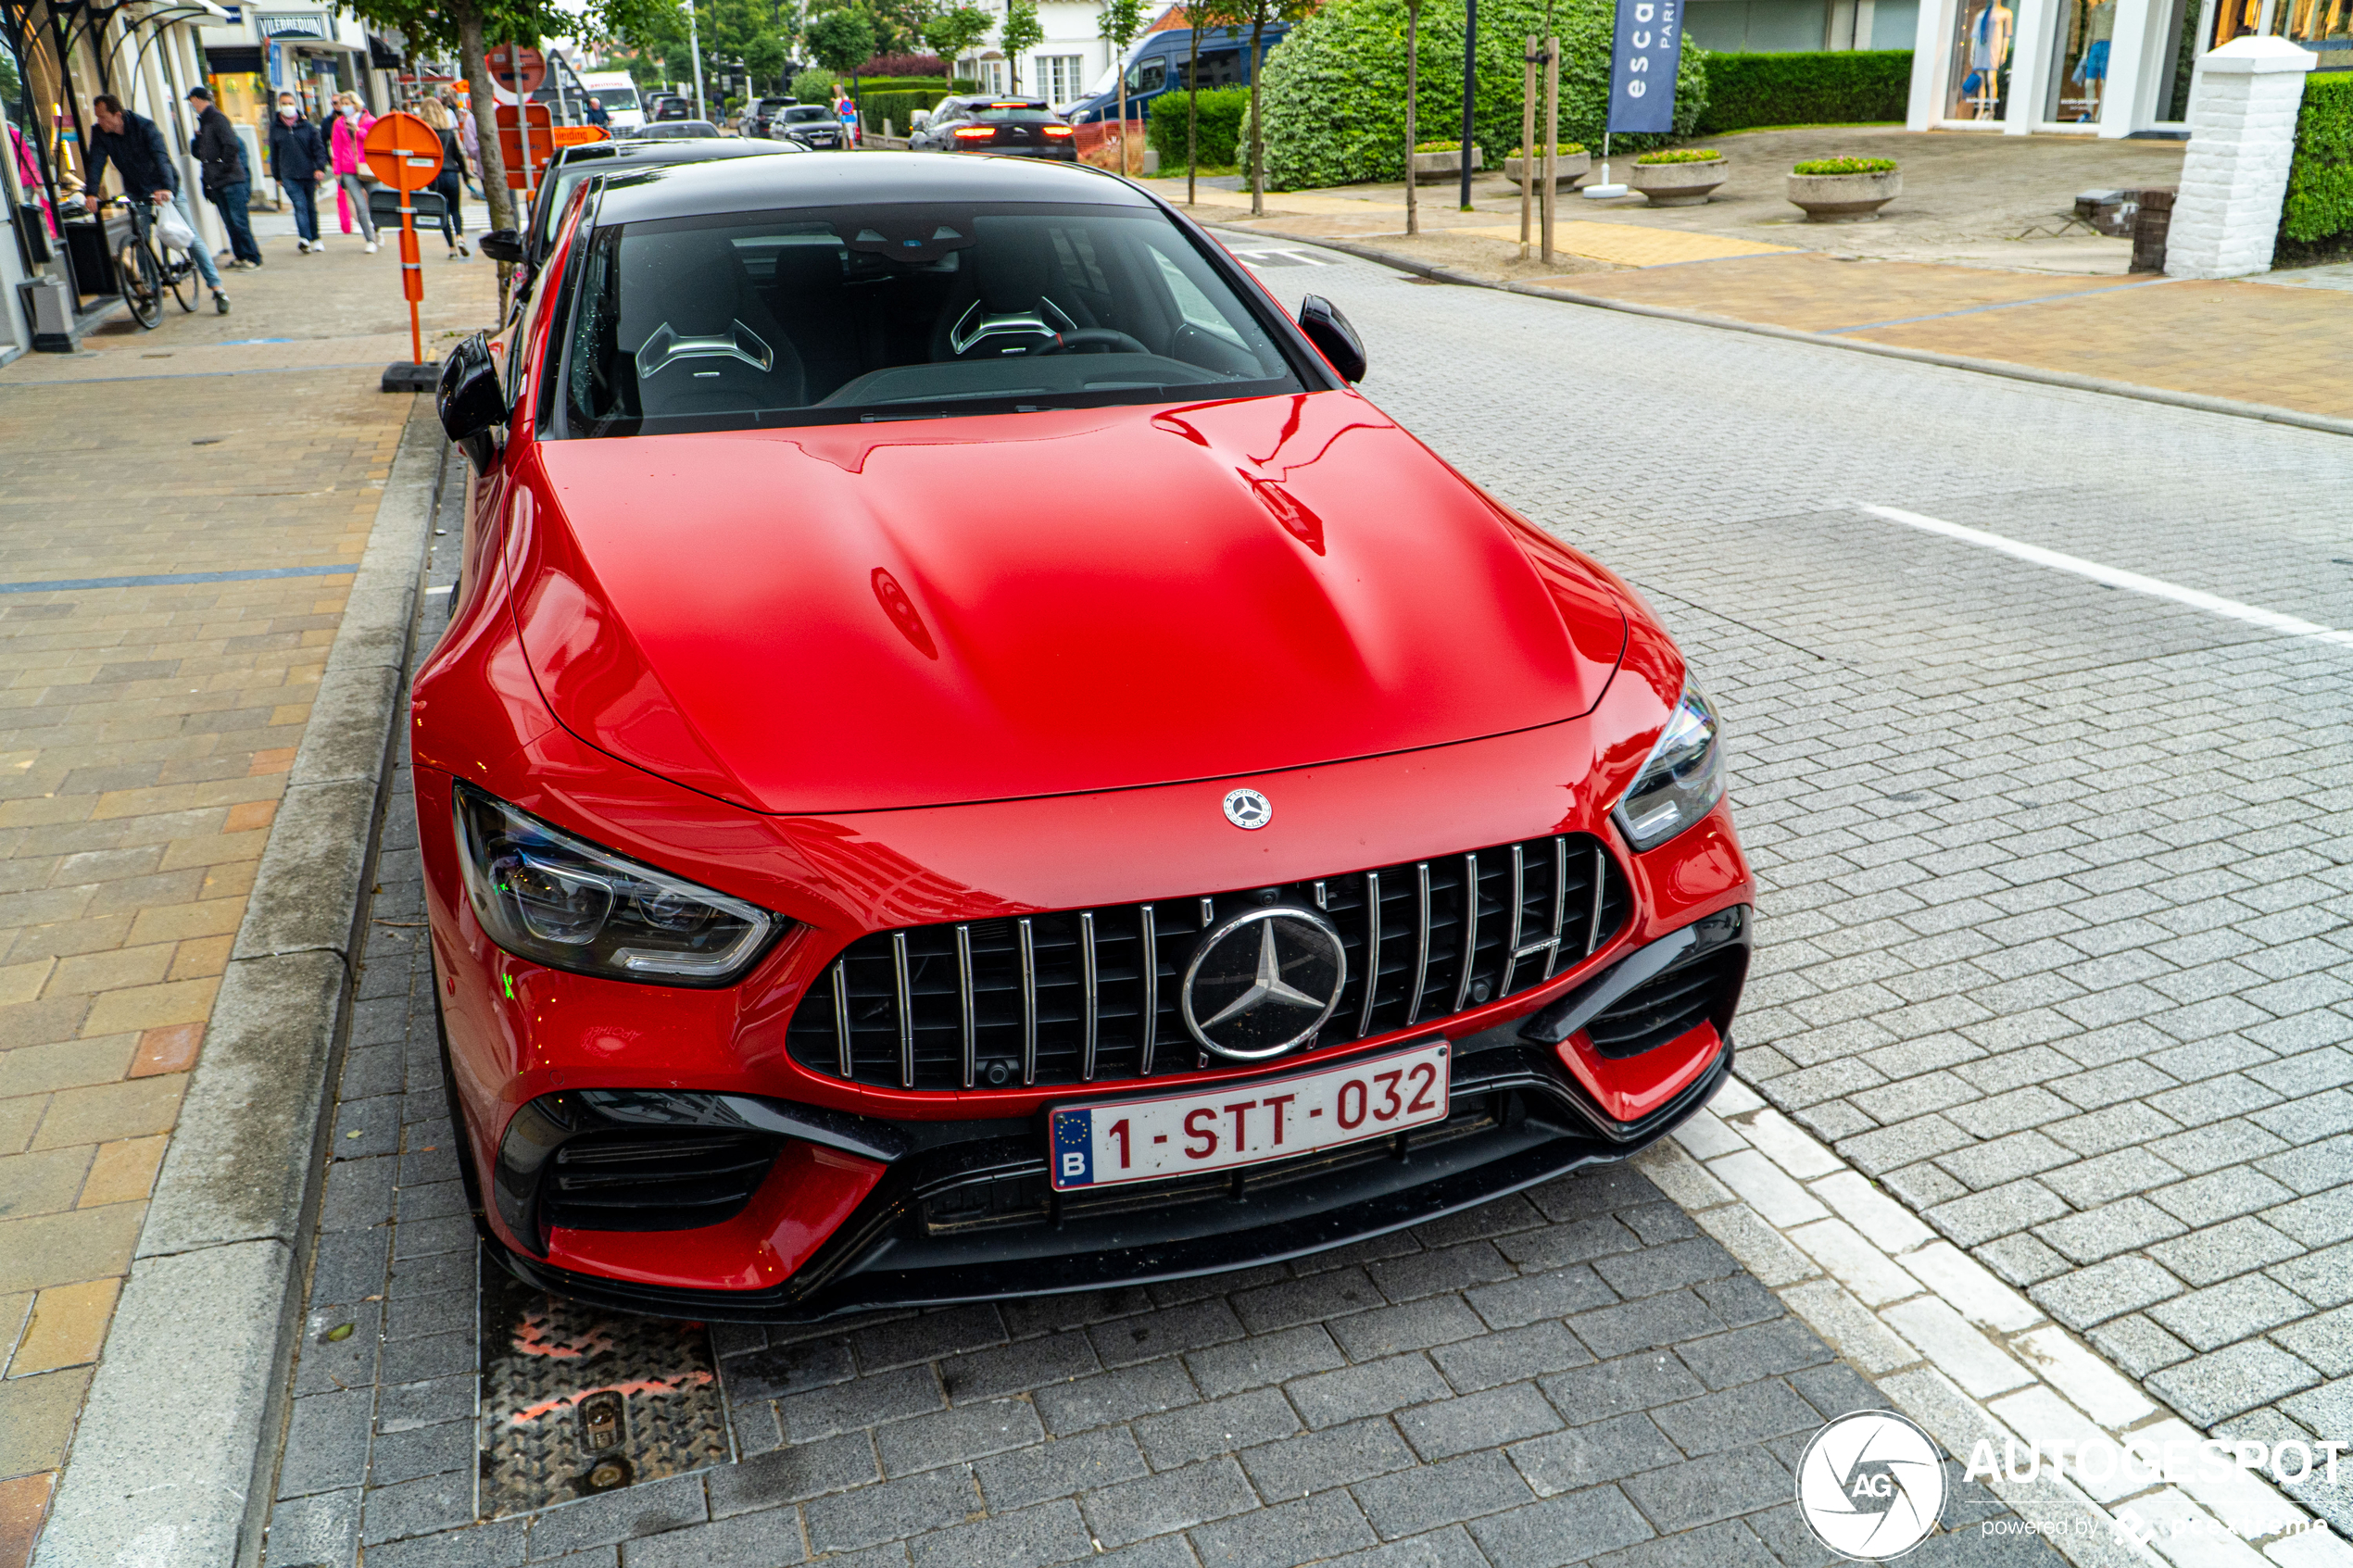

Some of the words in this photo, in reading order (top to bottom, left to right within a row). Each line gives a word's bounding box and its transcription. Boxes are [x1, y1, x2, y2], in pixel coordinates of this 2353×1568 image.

[258, 16, 323, 37] VILEBREQUIN
[1108, 1061, 1437, 1169] 1-STT-032
[1062, 1151, 1086, 1177] B
